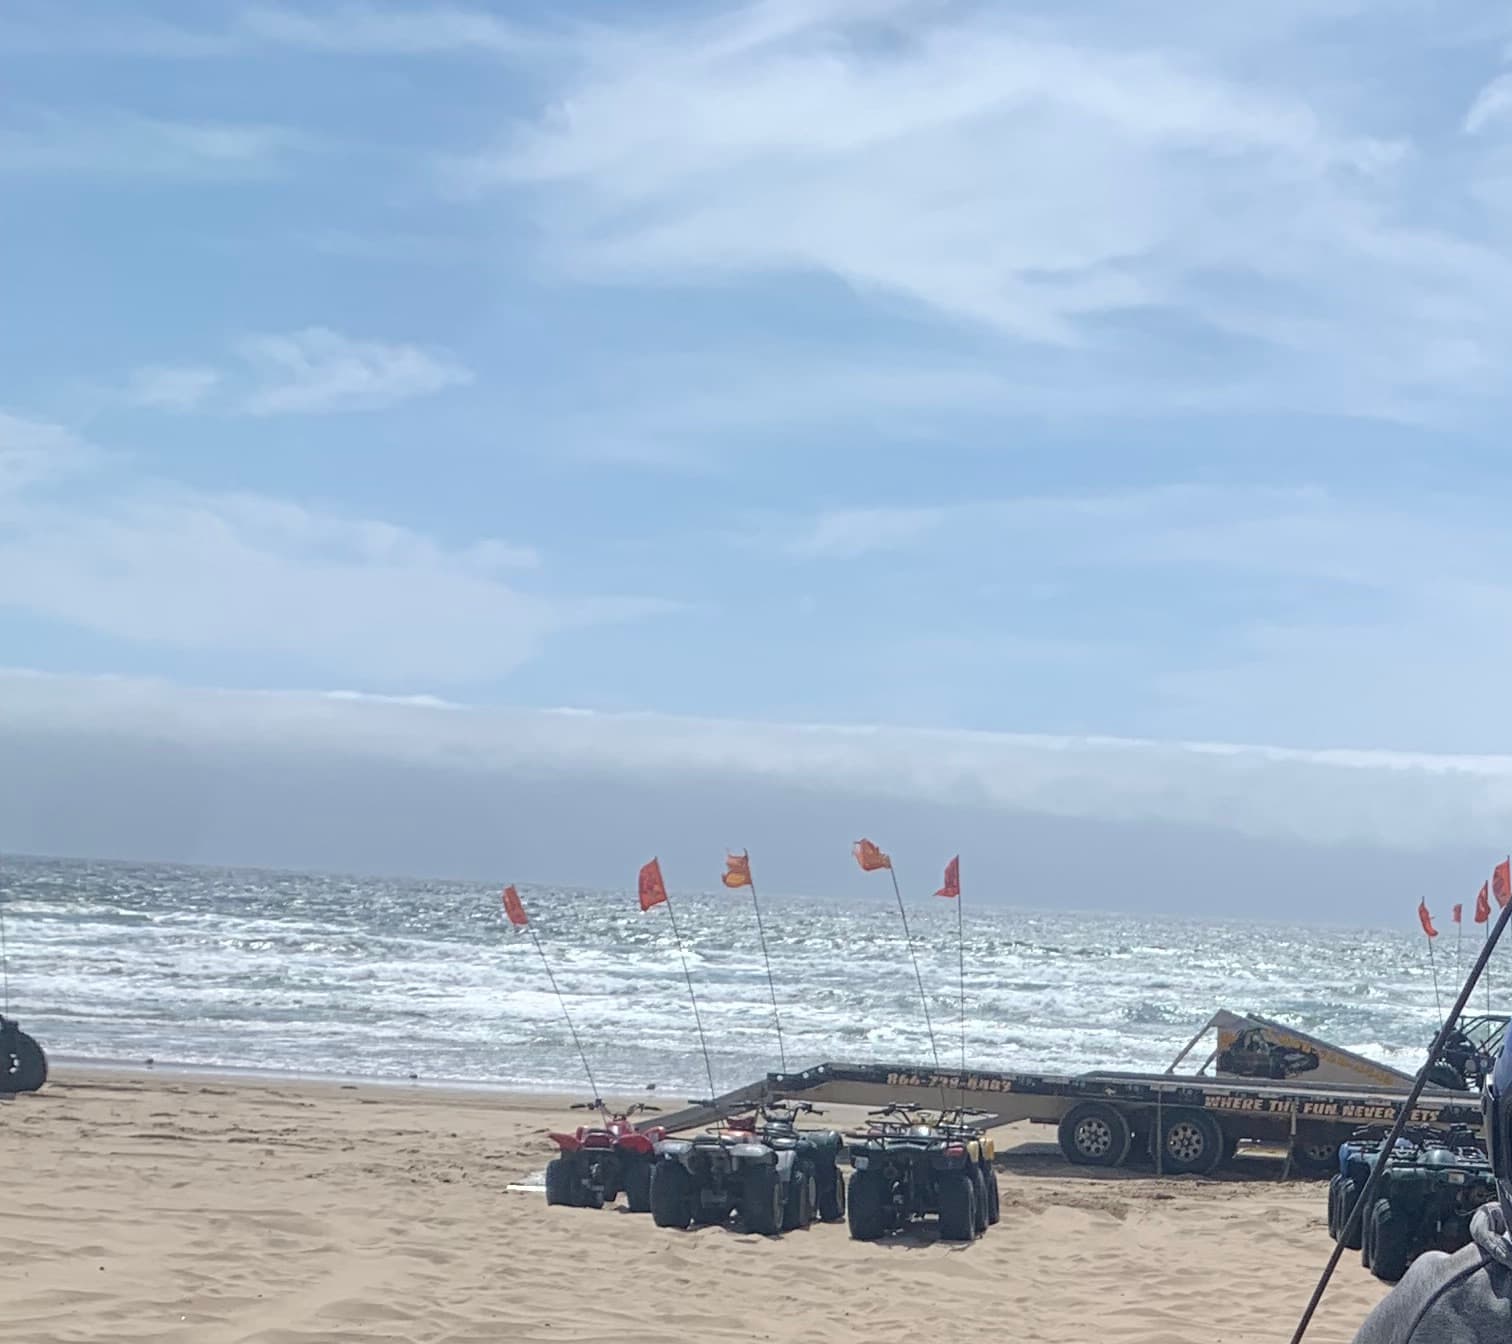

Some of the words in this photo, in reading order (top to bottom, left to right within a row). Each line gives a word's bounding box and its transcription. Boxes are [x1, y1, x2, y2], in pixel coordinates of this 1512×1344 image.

[1204, 1096, 1264, 1111] WHERE
[1268, 1100, 1298, 1113] THE
[1303, 1102, 1338, 1115] FUN
[1342, 1105, 1396, 1119] NEVER
[1402, 1108, 1440, 1122] ETS
